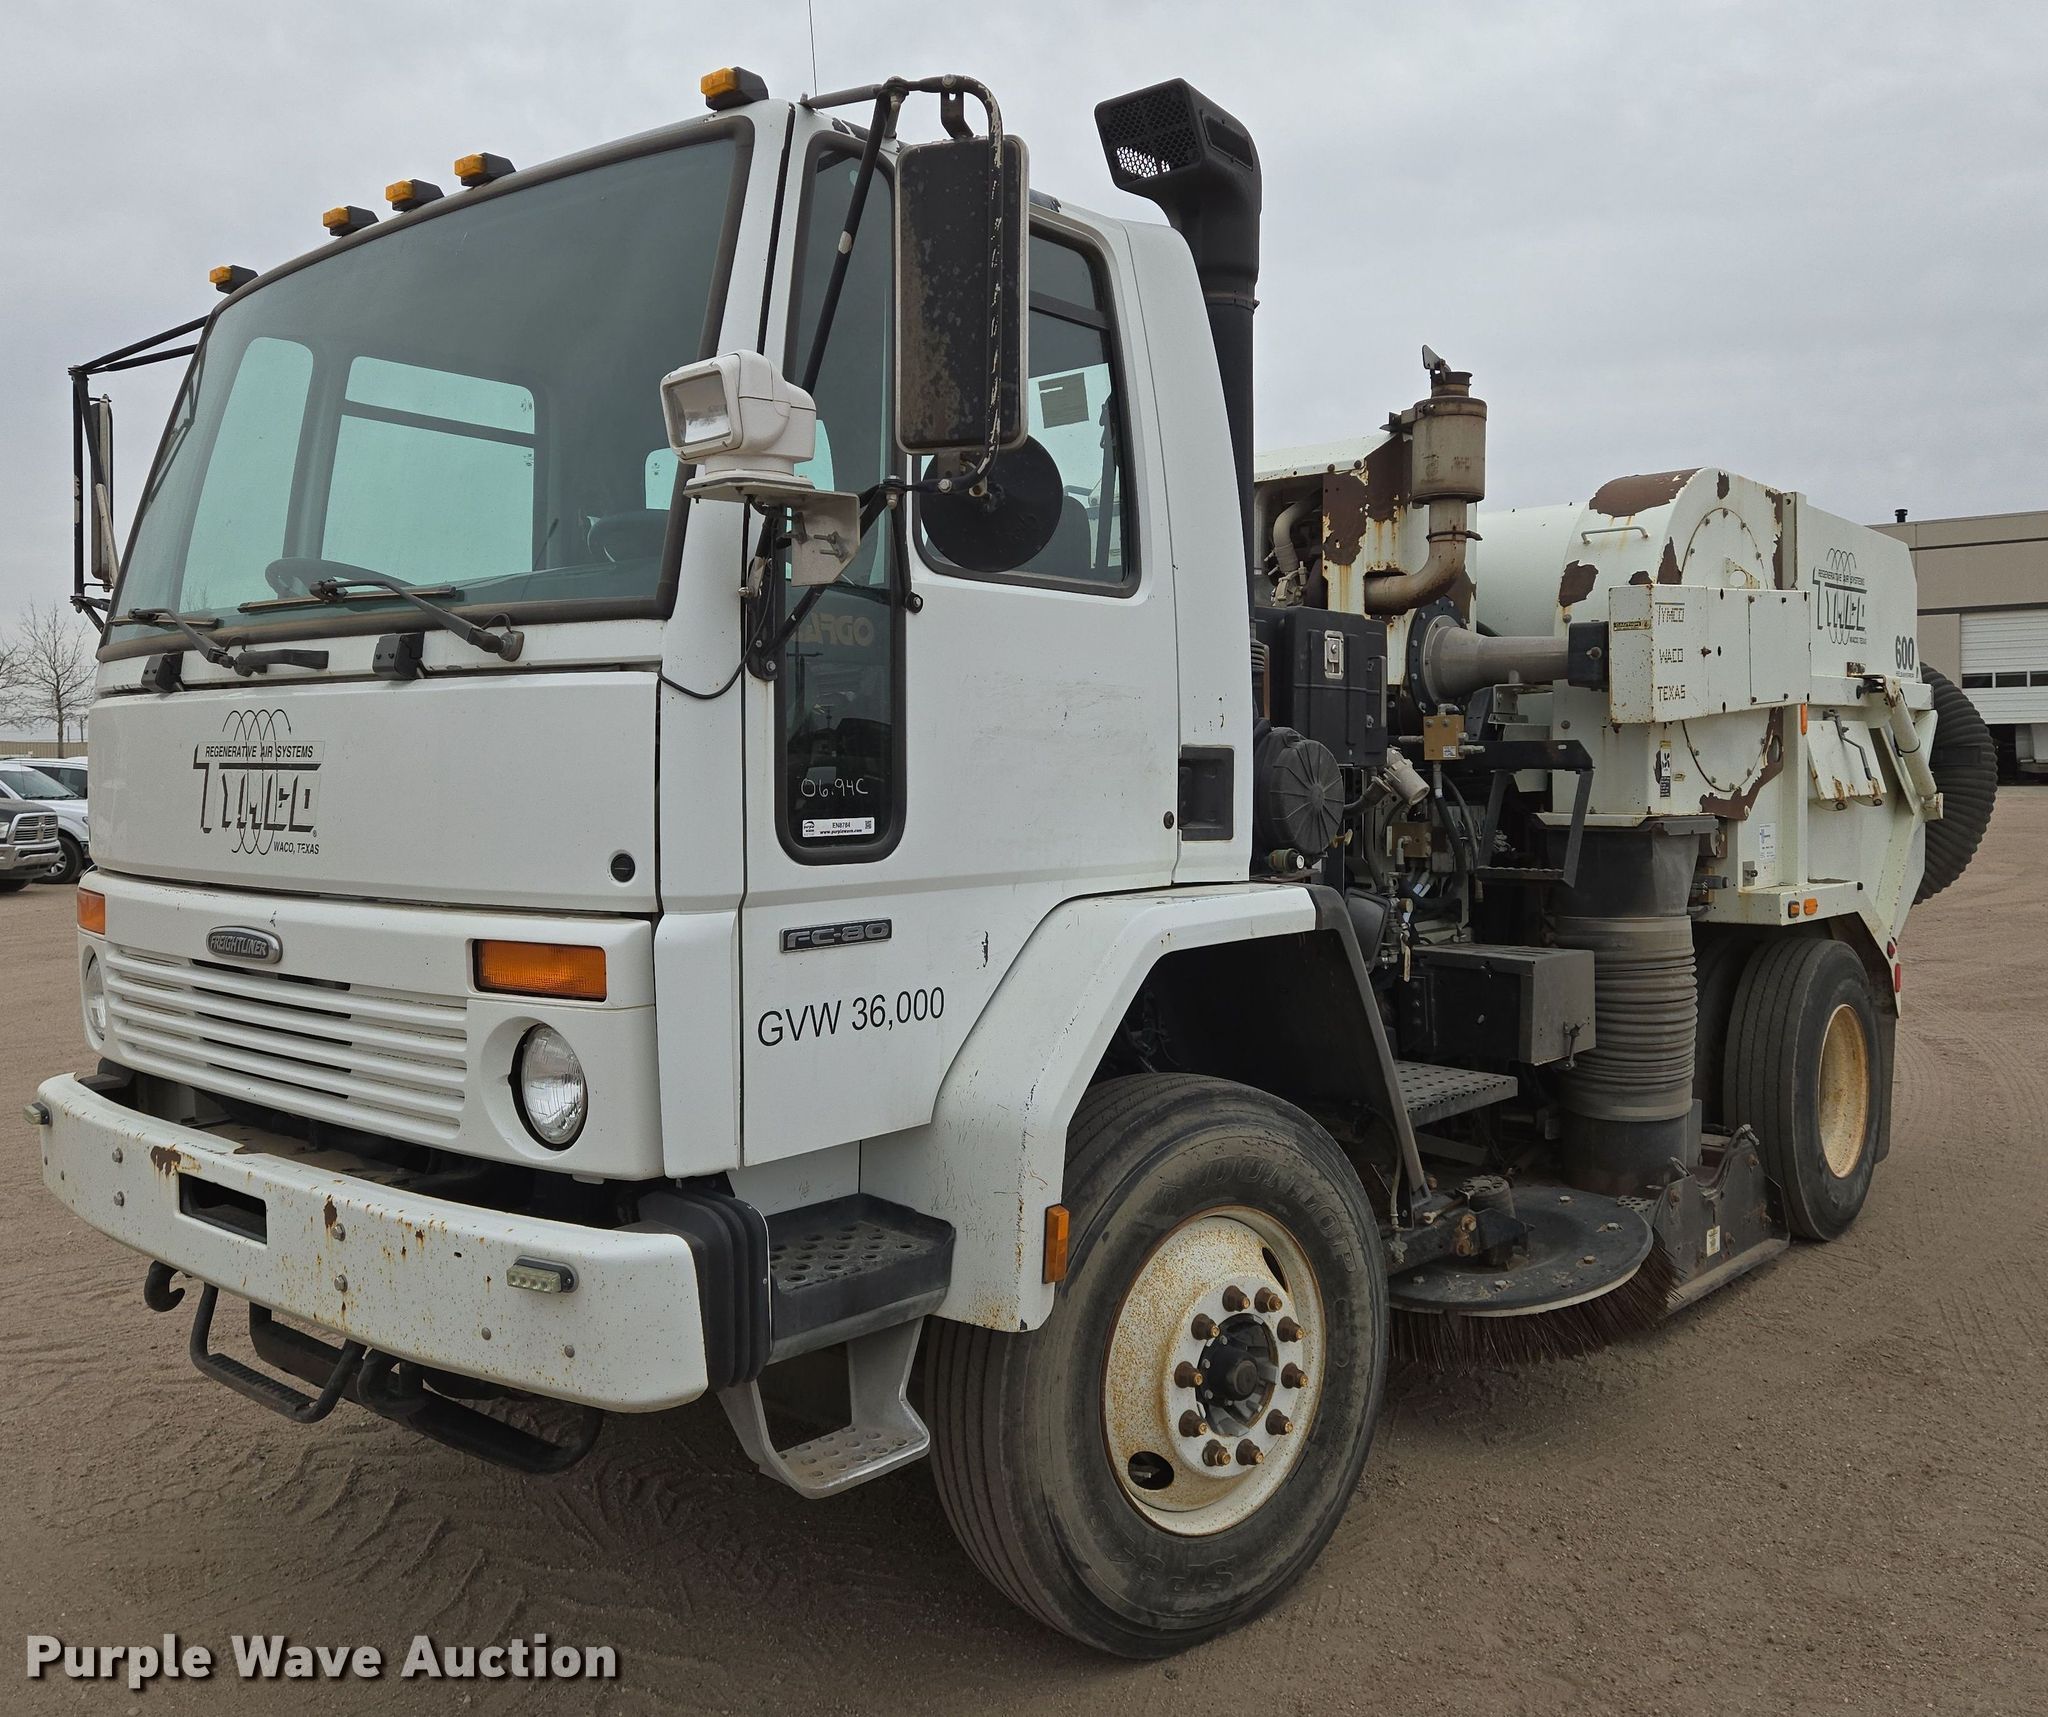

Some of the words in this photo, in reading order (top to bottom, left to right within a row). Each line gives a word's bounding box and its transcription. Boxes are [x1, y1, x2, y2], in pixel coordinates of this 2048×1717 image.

[1659, 648, 1684, 664] WACO
[1895, 635, 1915, 671] 600
[1657, 685, 1686, 702] TEXAS
[205, 745, 257, 758] REGENERATIVE
[260, 745, 274, 758] AIR
[276, 745, 314, 758] SYSTEMS
[297, 842, 320, 855] TEXAS
[787, 922, 890, 949] FC-80
[210, 935, 268, 956] FREIGHTLINER
[758, 1000, 842, 1047] GVW
[851, 986, 945, 1031] 36,000
